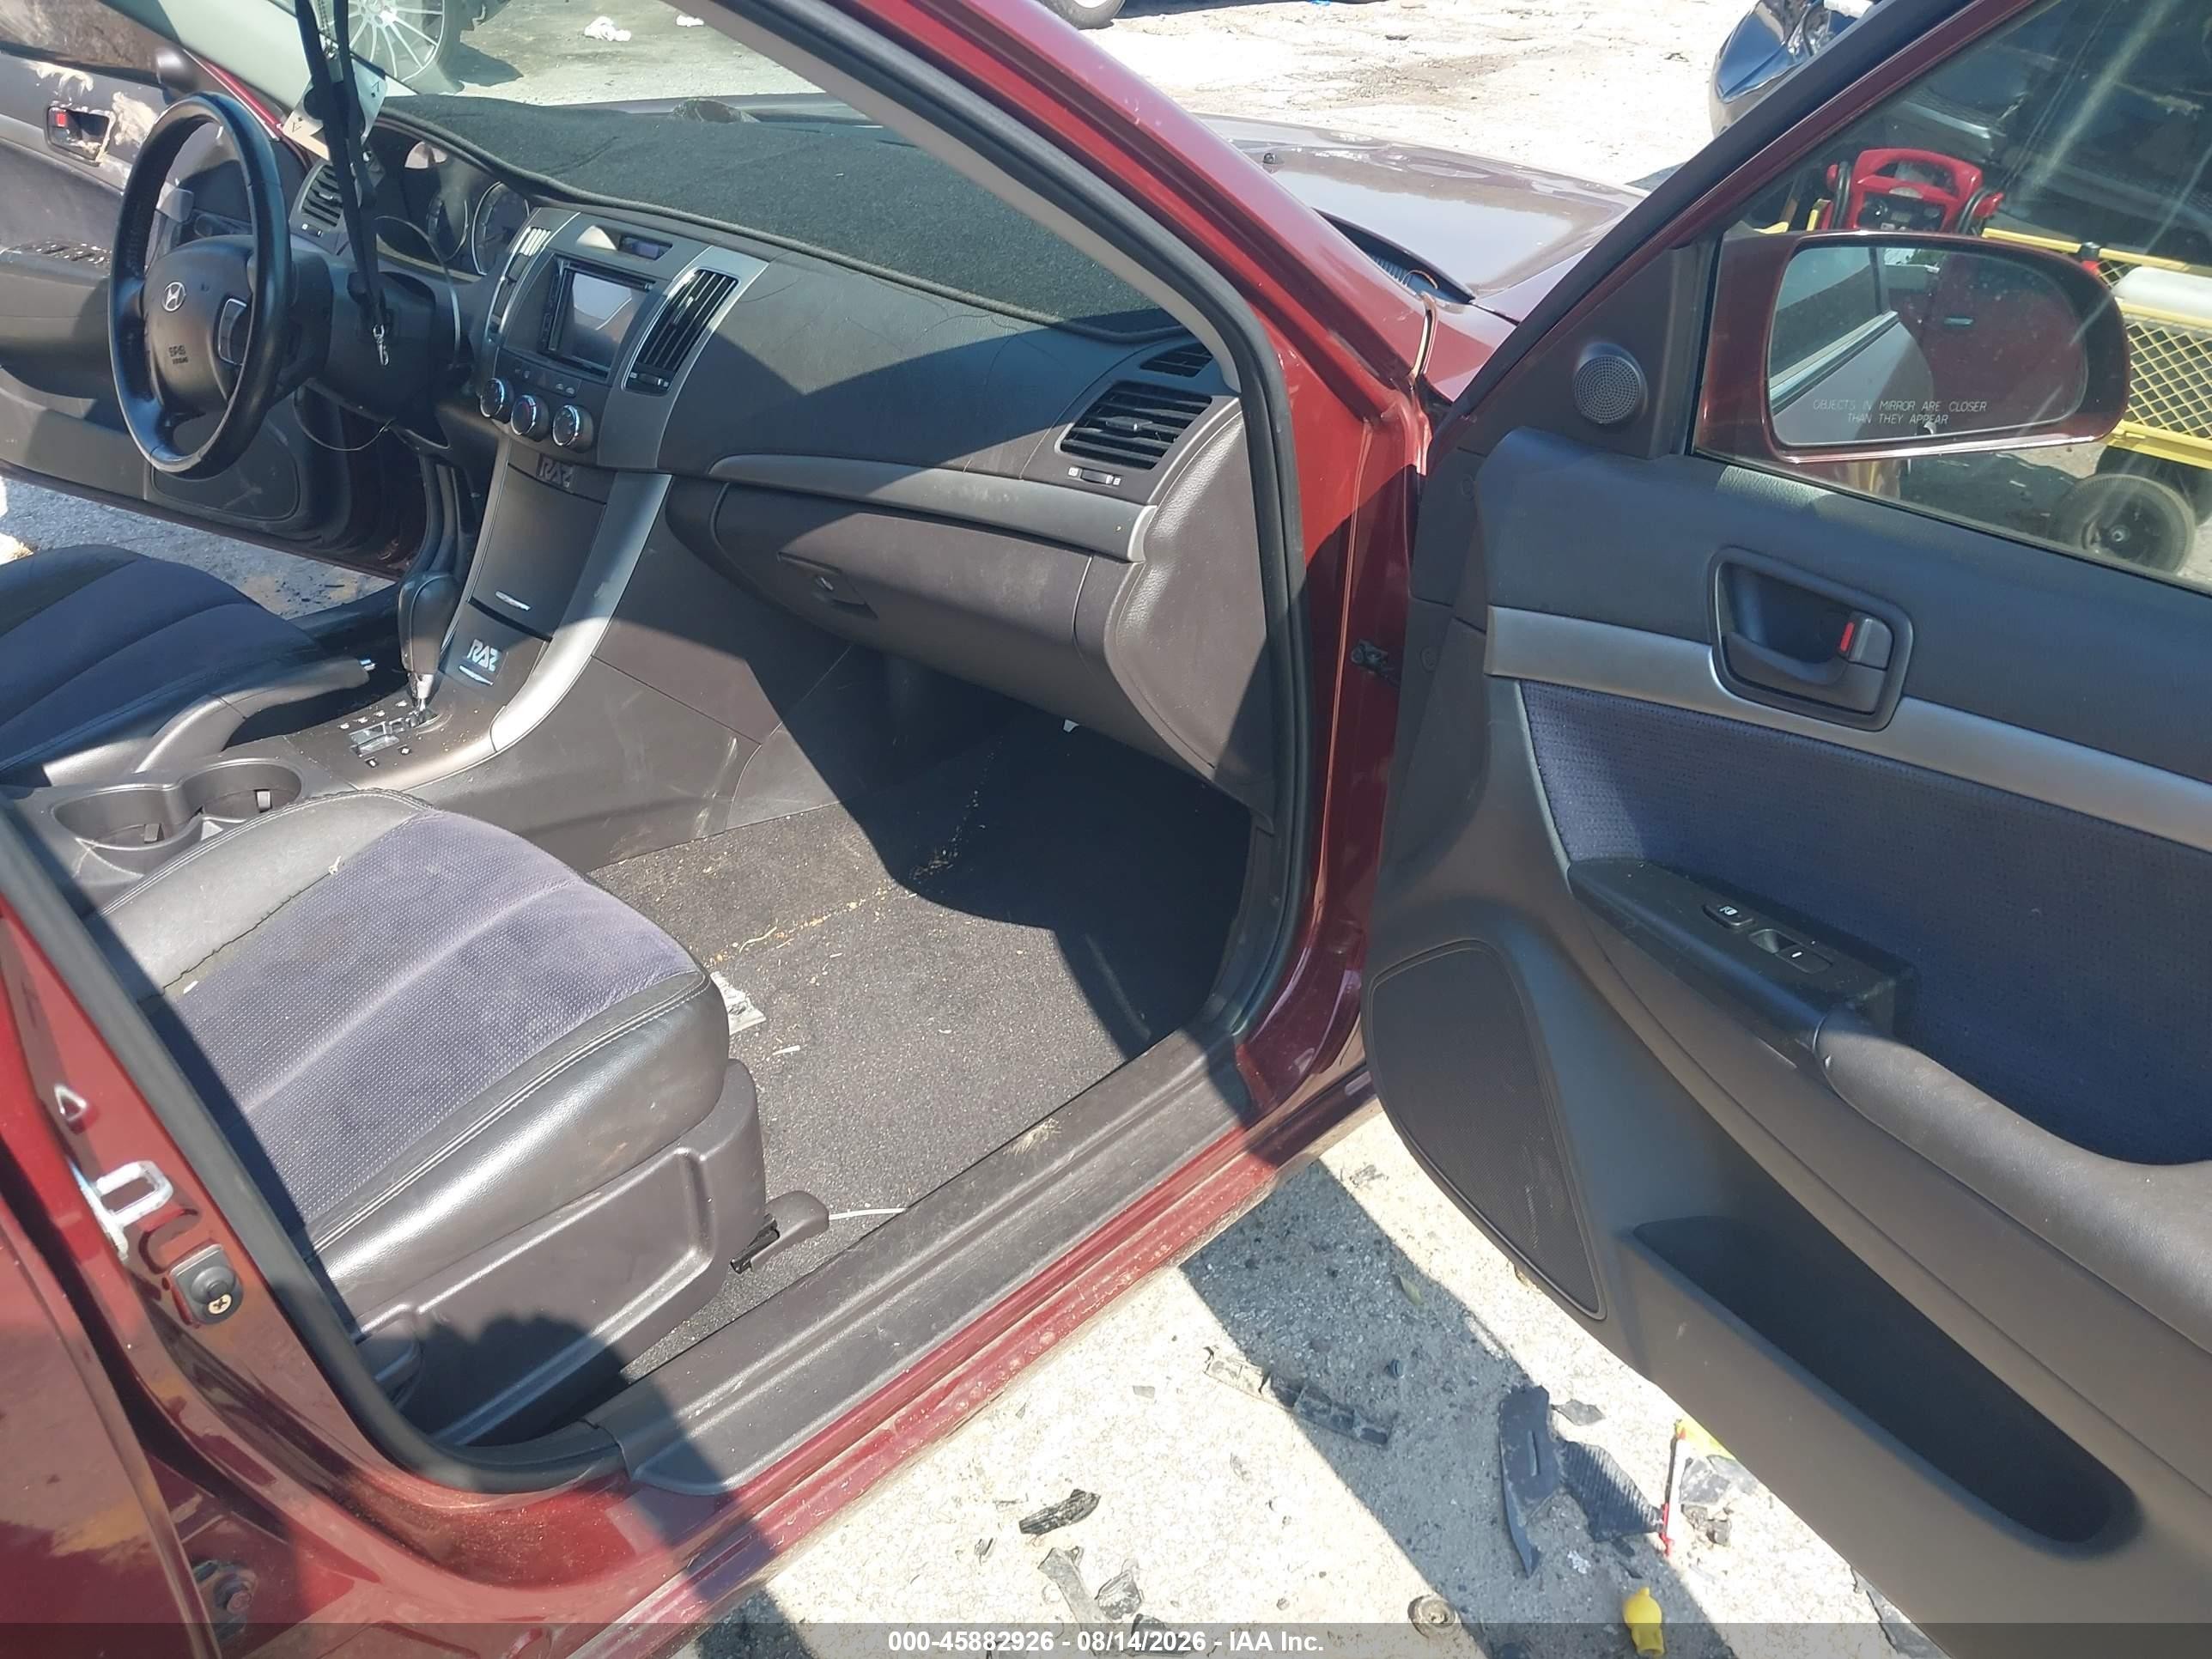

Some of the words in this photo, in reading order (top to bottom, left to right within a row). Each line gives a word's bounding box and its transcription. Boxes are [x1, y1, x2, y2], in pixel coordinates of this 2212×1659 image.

[1813, 399, 1856, 410] OBJECTS
[1862, 400, 1873, 410] IN
[1879, 400, 1916, 411] MIRROR
[1922, 401, 1941, 411] ARE
[1948, 401, 1987, 412] CLOSER
[1847, 412, 1873, 424] THAN
[1879, 413, 1903, 424] THEY
[1909, 414, 1948, 425] APPEAR
